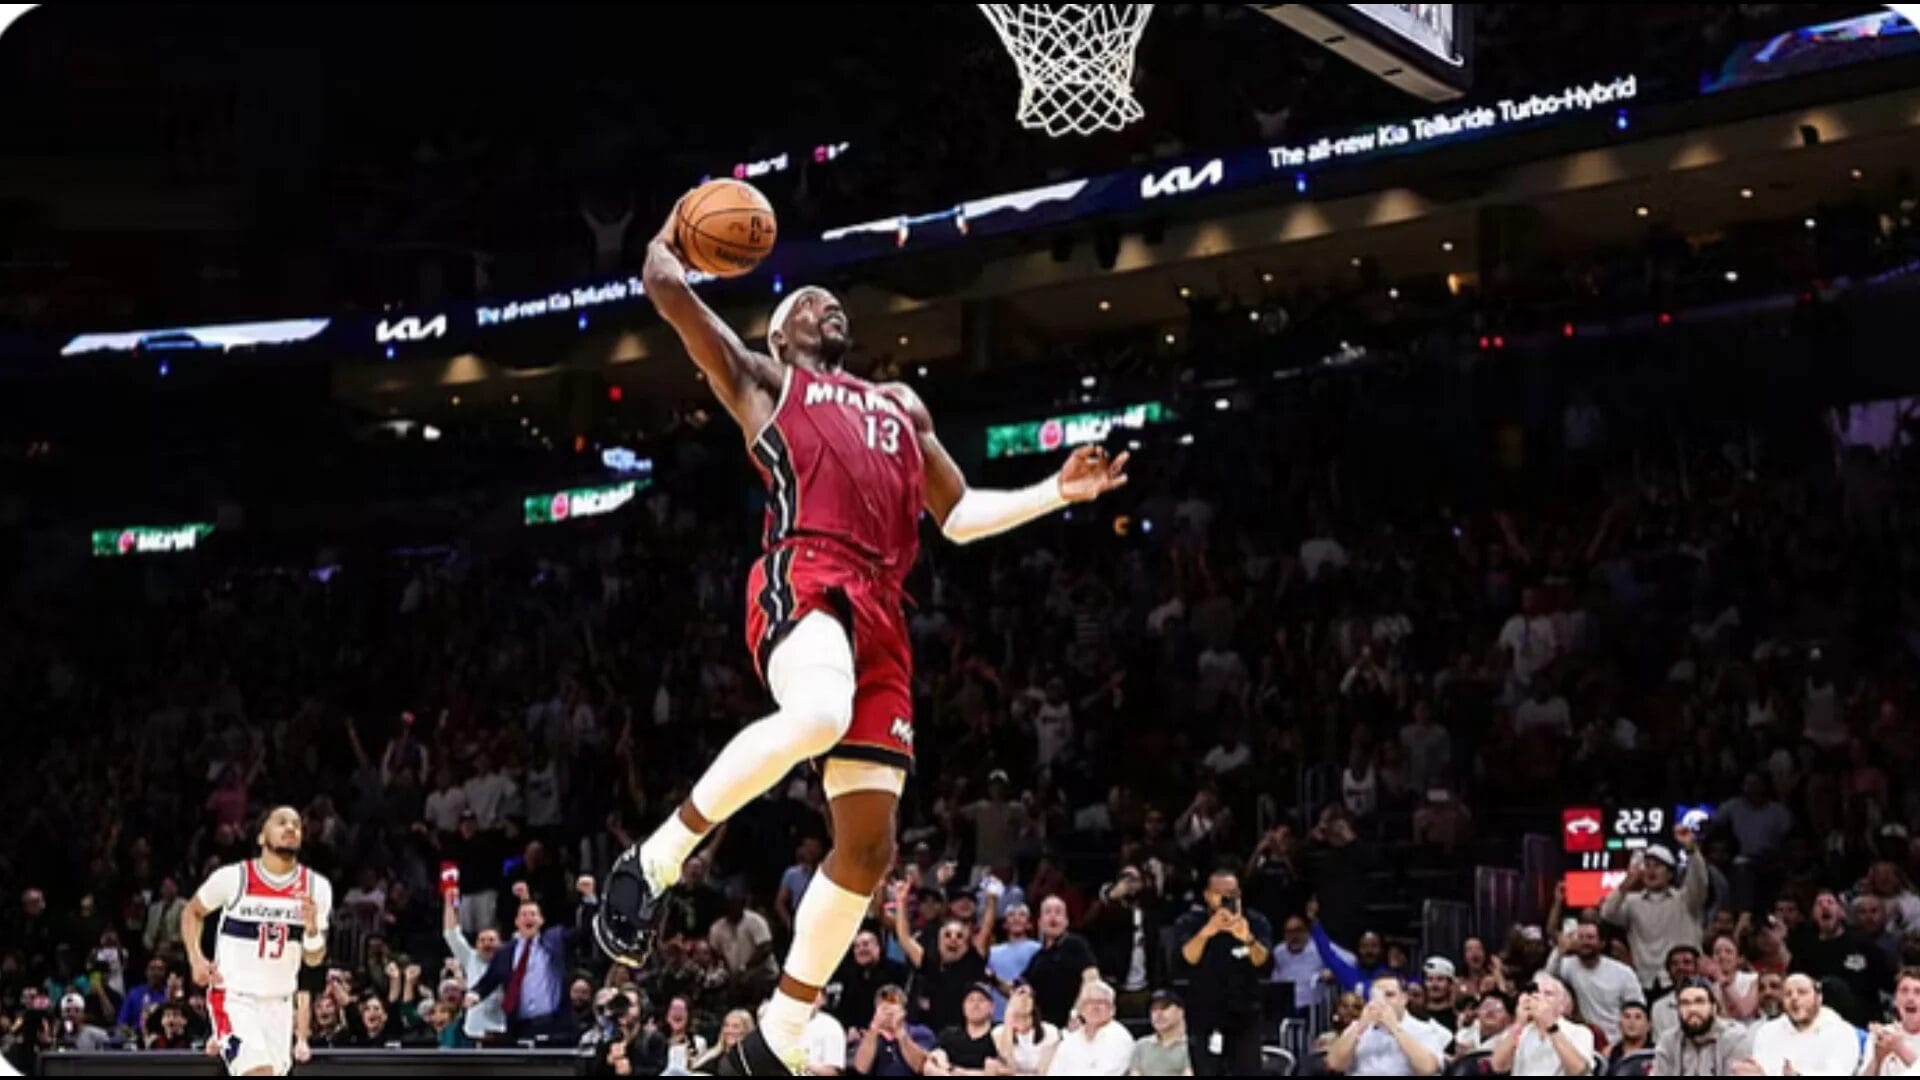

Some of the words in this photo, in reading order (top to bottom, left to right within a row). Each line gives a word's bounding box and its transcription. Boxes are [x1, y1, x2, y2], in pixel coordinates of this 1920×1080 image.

[1268, 145, 1306, 169] The
[1306, 131, 1376, 162] all-new
[1377, 121, 1410, 147] Kia
[1411, 106, 1497, 140] Telluride
[1497, 73, 1638, 123] Turbo-Hybrid
[1140, 157, 1224, 198] KIA
[864, 414, 900, 455] 13
[1614, 808, 1664, 834] 22.9
